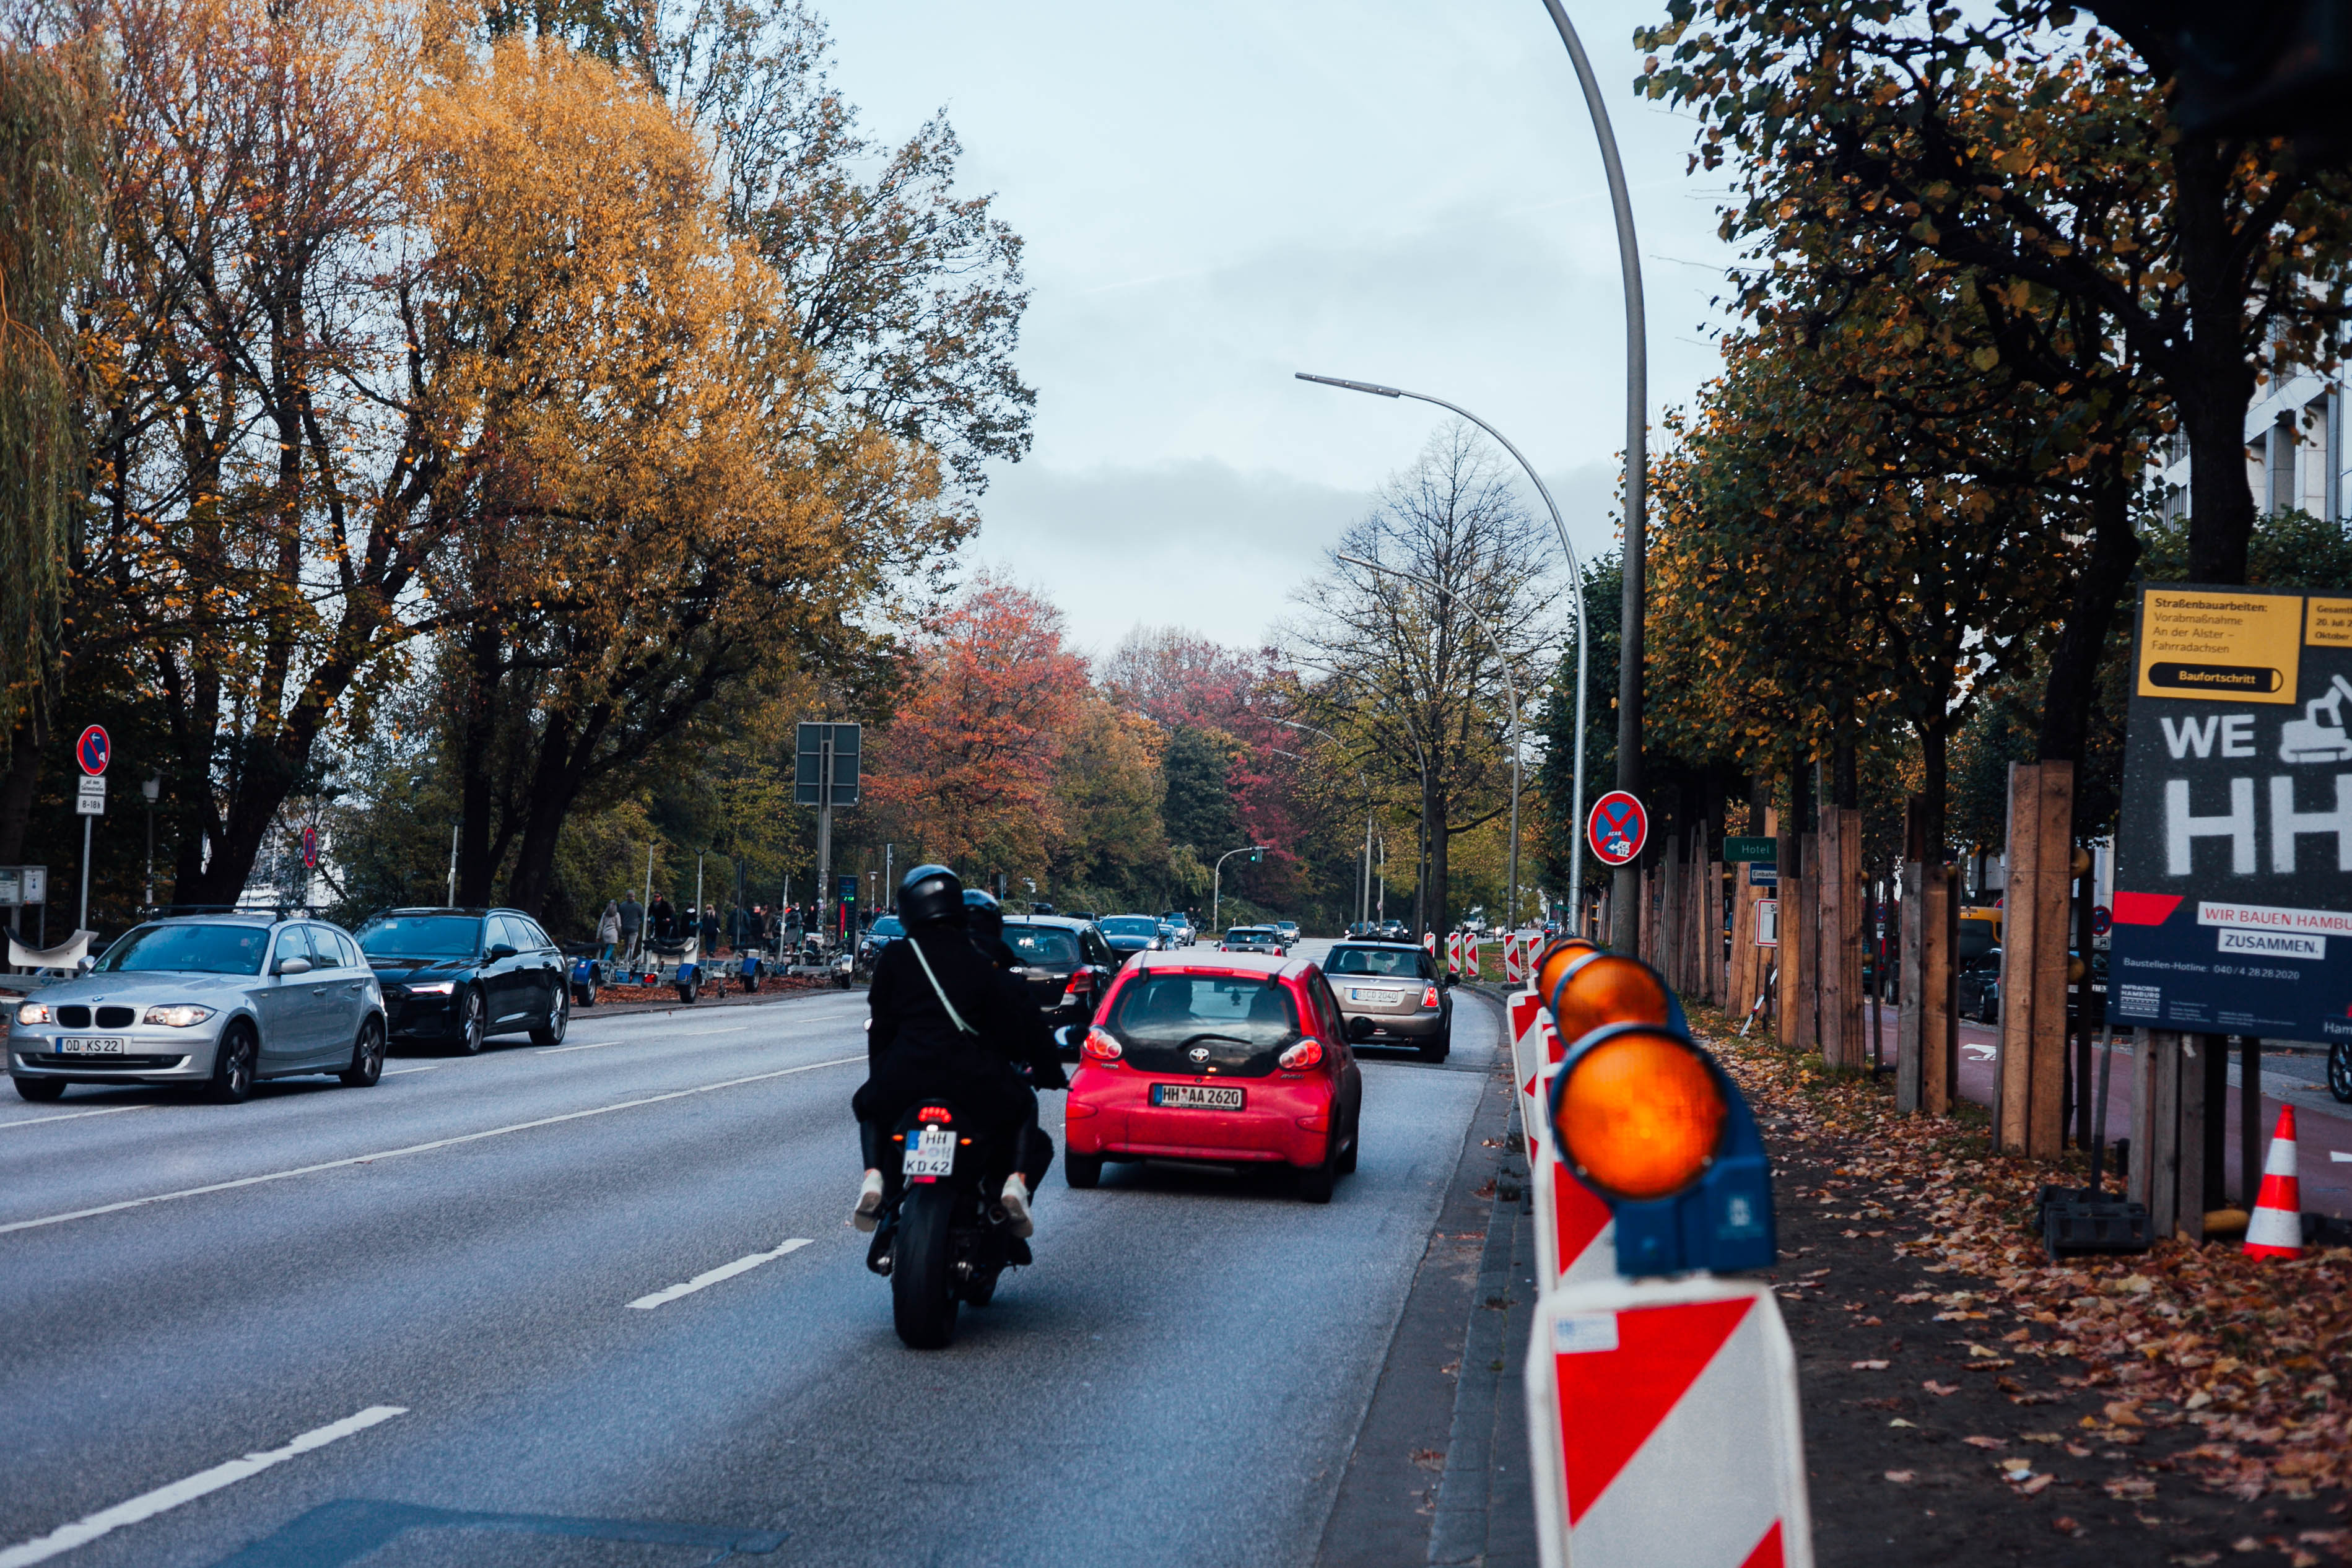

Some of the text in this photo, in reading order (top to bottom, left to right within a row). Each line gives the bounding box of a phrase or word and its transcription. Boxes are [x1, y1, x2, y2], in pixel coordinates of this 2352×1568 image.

[2155, 598, 2268, 612] Straßenbauarbeiten:
[2154, 612, 2244, 626] Vorabmaßnahme
[2153, 626, 2167, 636] An
[2171, 627, 2189, 637] der
[2192, 628, 2225, 639] Alster
[2315, 631, 2350, 640] Oktober
[2151, 640, 2230, 653] Fahrradachsen
[2179, 670, 2256, 684] Baufortschritt
[2160, 714, 2256, 759] WE
[2166, 774, 2352, 876] HH
[1741, 844, 1769, 854] Hotel
[2205, 908, 2235, 921] WIR
[2239, 910, 2291, 926] BAUEN
[2225, 934, 2319, 953] ZUSAMMEN.
[66, 1040, 118, 1052] OD KS 22
[1163, 1087, 1239, 1105] HH AA 2620
[926, 1133, 947, 1144] HH
[906, 1161, 949, 1173] KD 42
